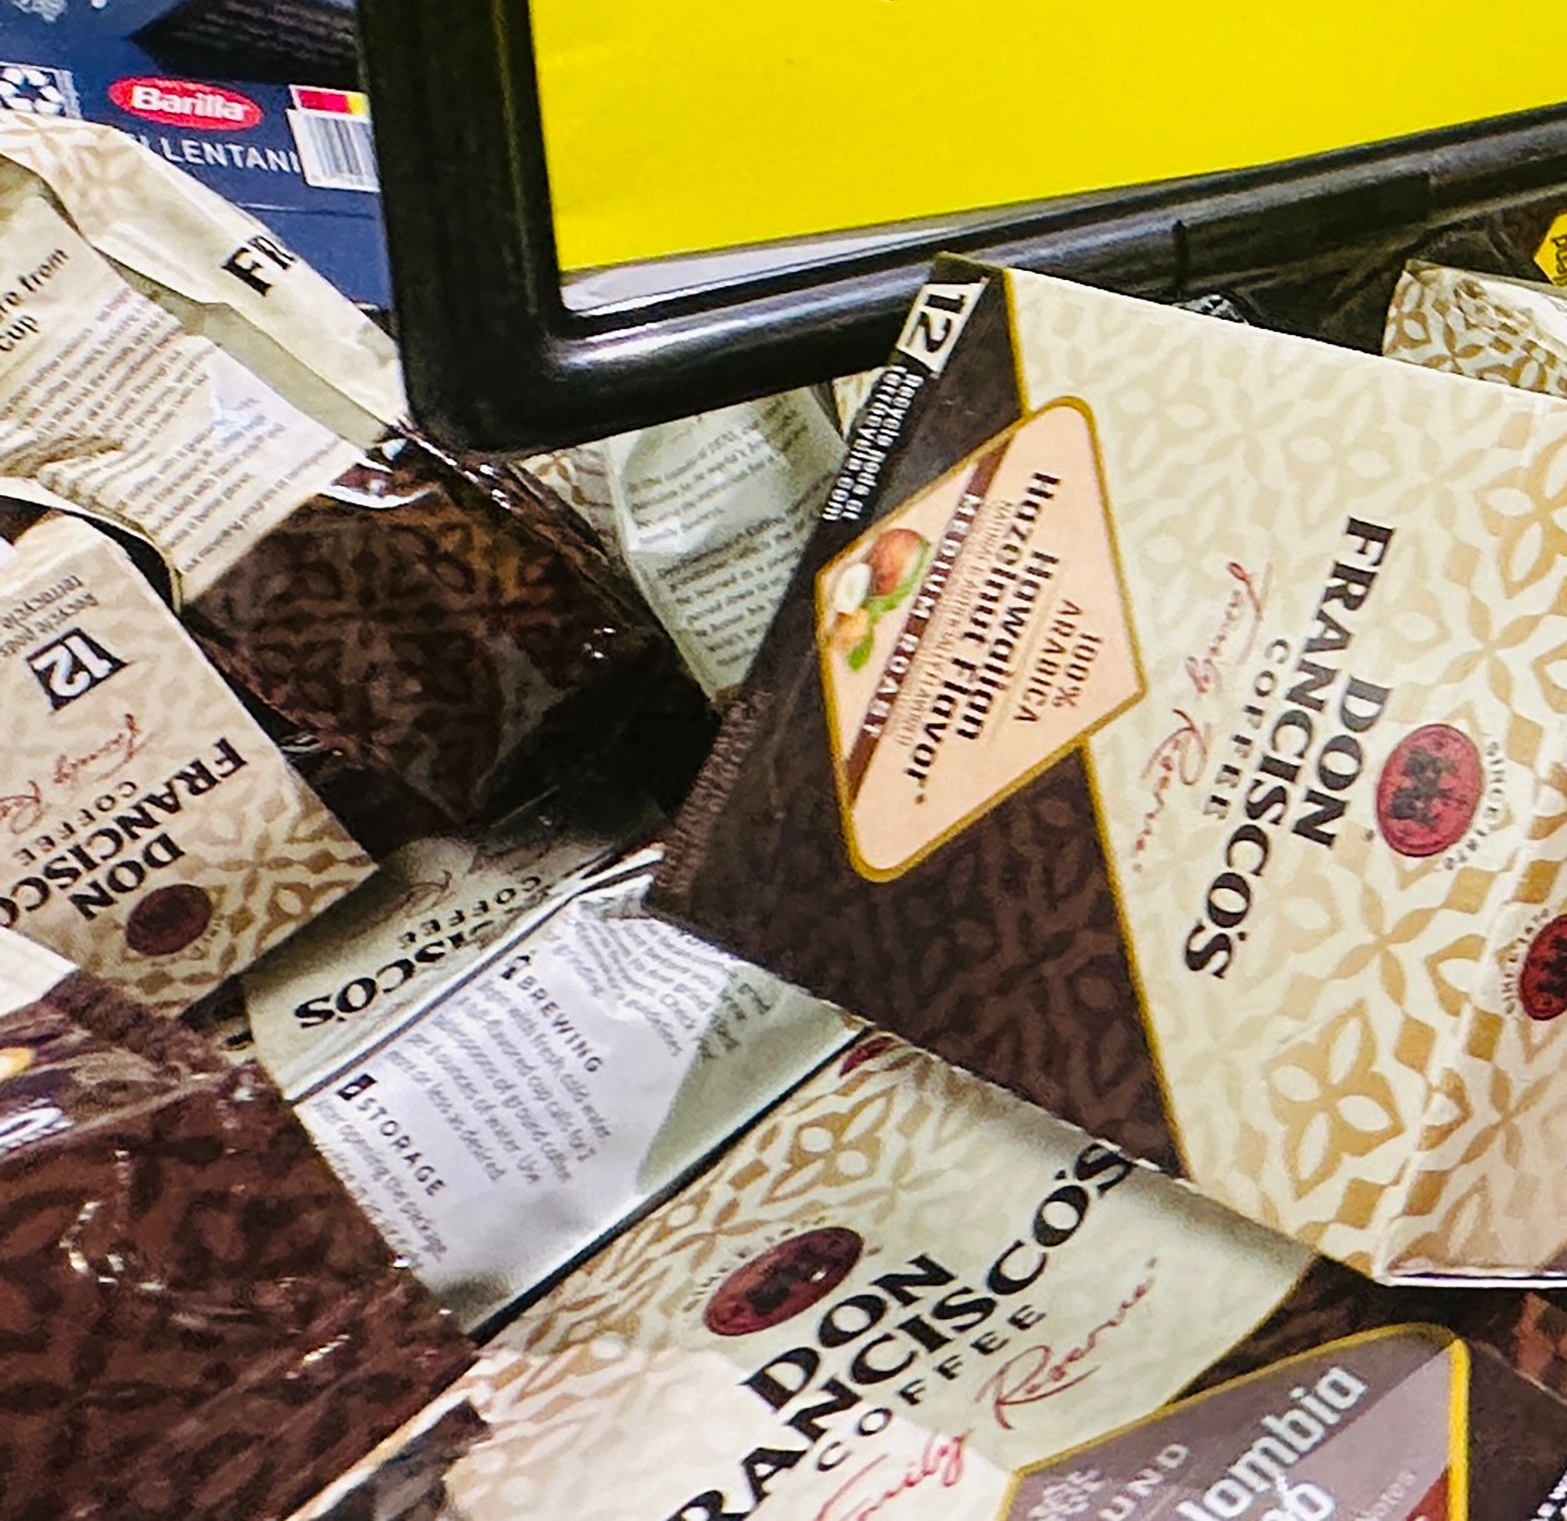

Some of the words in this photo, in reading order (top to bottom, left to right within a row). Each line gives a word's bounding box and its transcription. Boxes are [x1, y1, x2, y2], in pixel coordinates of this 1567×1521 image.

[131, 83, 247, 123] Barilla
[906, 288, 969, 356] 12
[913, 498, 981, 619] MEDIUM
[961, 472, 1061, 644] Hazelnut
[31, 629, 117, 703] 12
[958, 552, 1059, 737] Hawaiian
[1015, 600, 1082, 725] ARABICA
[1054, 635, 1103, 708] 100%
[1183, 514, 1399, 980] FRANCISCO'S
[1202, 638, 1290, 822] COFFEE
[1290, 674, 1393, 851] DON
[12, 780, 139, 866] COFFEE
[68, 833, 186, 922] DON
[515, 974, 603, 1073] BREWING
[358, 1099, 446, 1196] STORAGE
[740, 1253, 960, 1414] DON
[817, 1302, 1047, 1473] COFFEE
